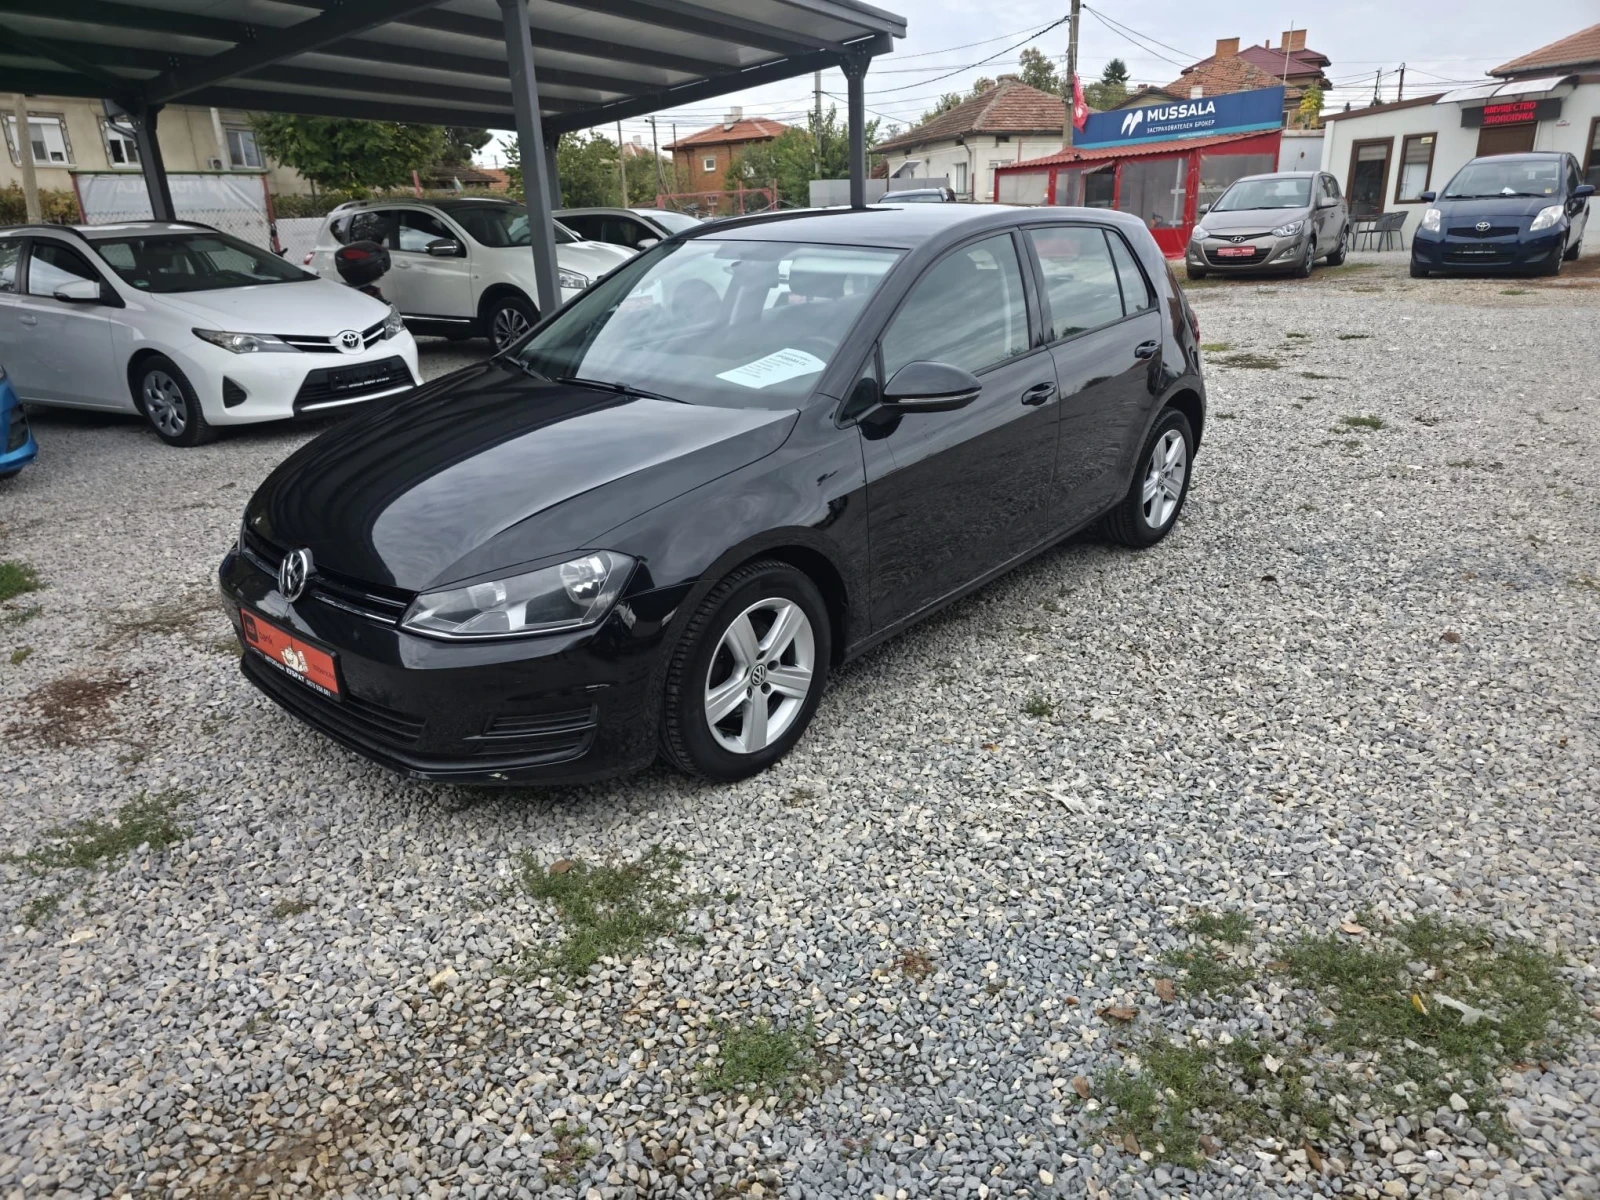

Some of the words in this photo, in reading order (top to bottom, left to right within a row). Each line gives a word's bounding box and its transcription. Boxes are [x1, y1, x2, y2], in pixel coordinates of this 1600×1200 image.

[1147, 101, 1216, 122] MUSSALA
[1146, 123, 1193, 134] ЗАСТРАХОВАТЕЛЕН
[1194, 119, 1216, 128] БРОКЕР
